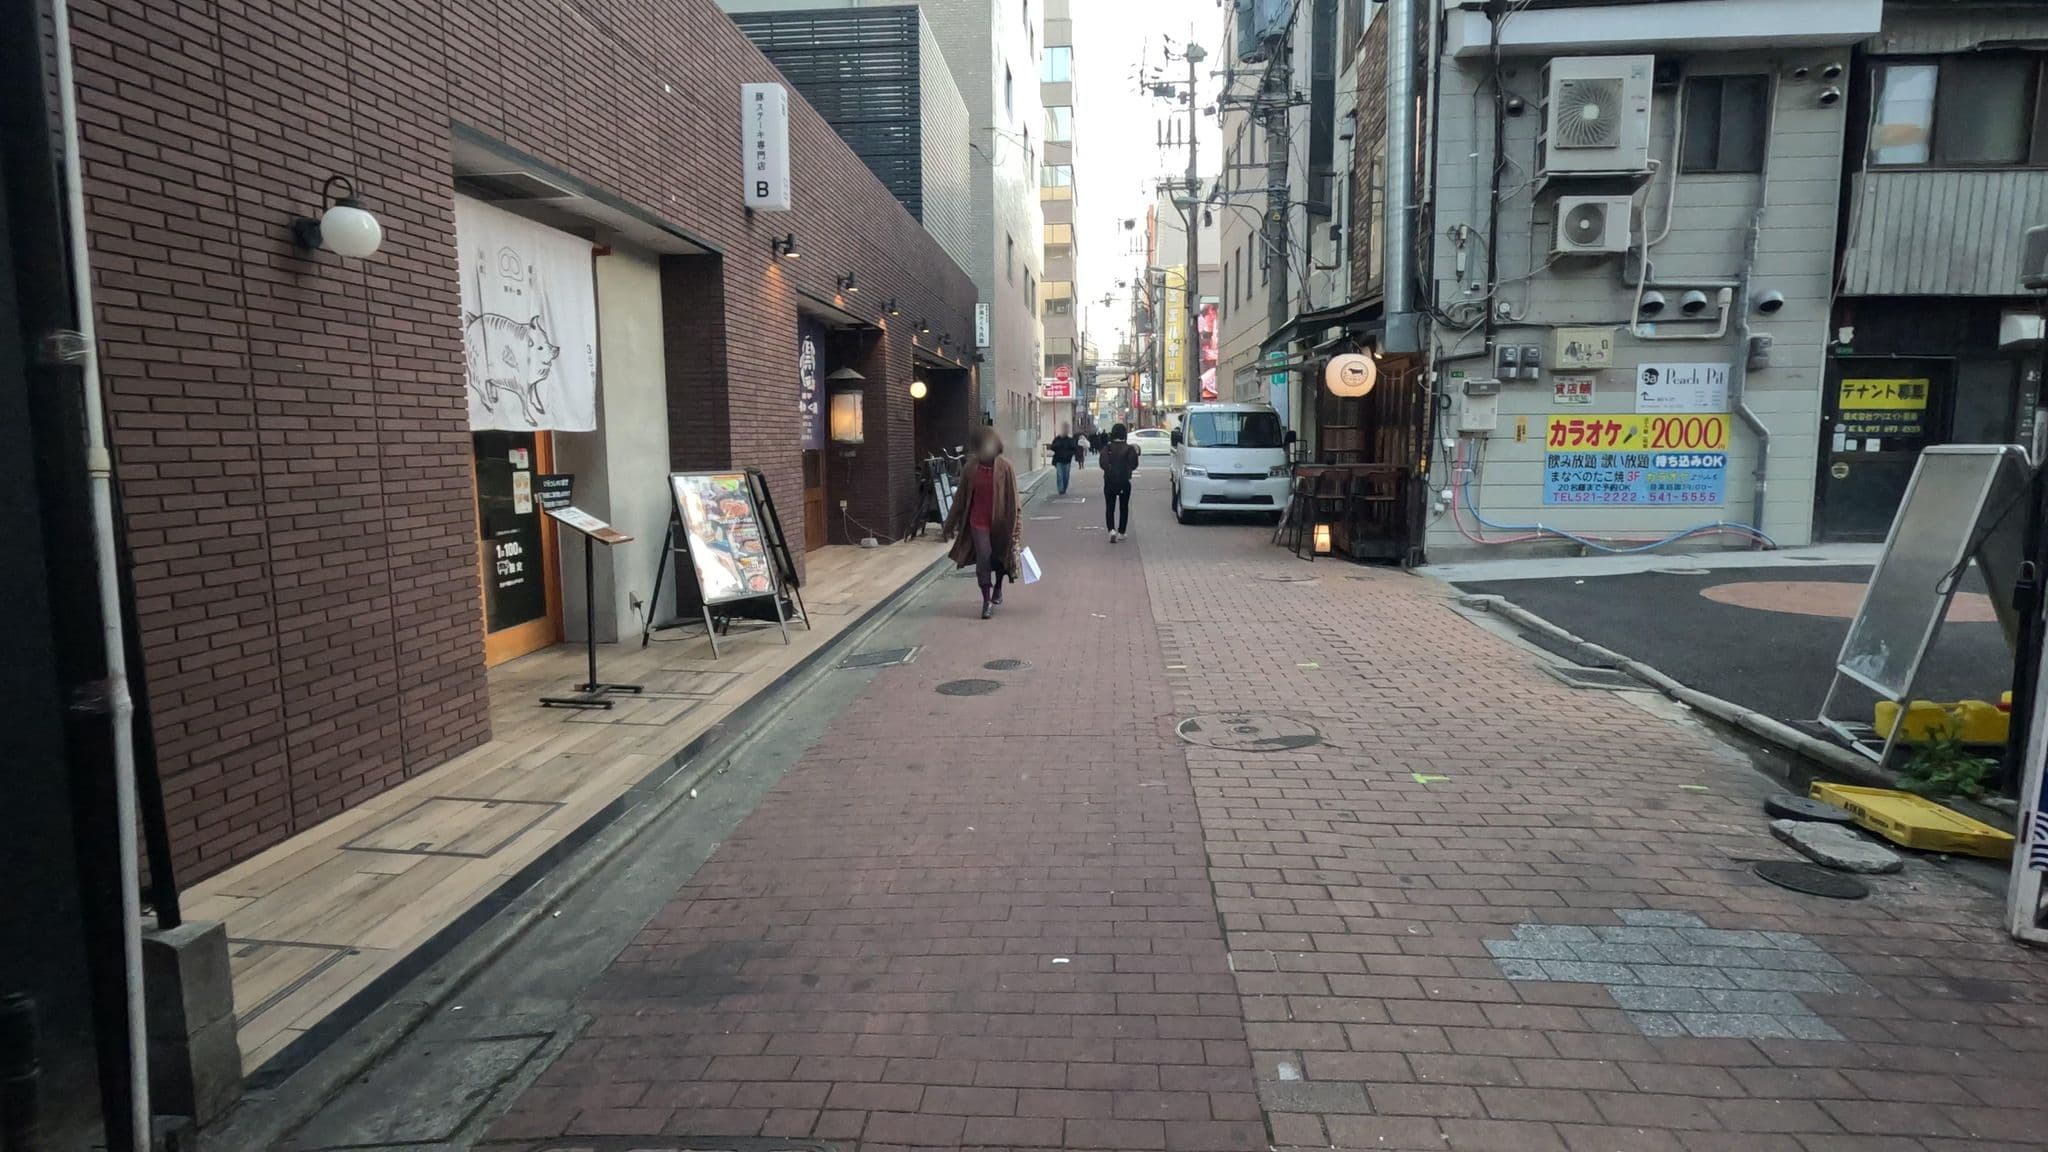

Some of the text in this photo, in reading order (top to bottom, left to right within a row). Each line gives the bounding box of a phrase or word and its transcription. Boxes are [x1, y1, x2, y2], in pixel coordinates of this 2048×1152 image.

[756, 181, 769, 198] B
[1665, 367, 1726, 385] Peach Pit
[1549, 419, 1622, 447] カラオケ
[1548, 453, 1597, 468] 飲み放題
[1655, 455, 1723, 468] 持ち込みOK
[1551, 471, 1640, 483] まなべのたこ焼 3F
